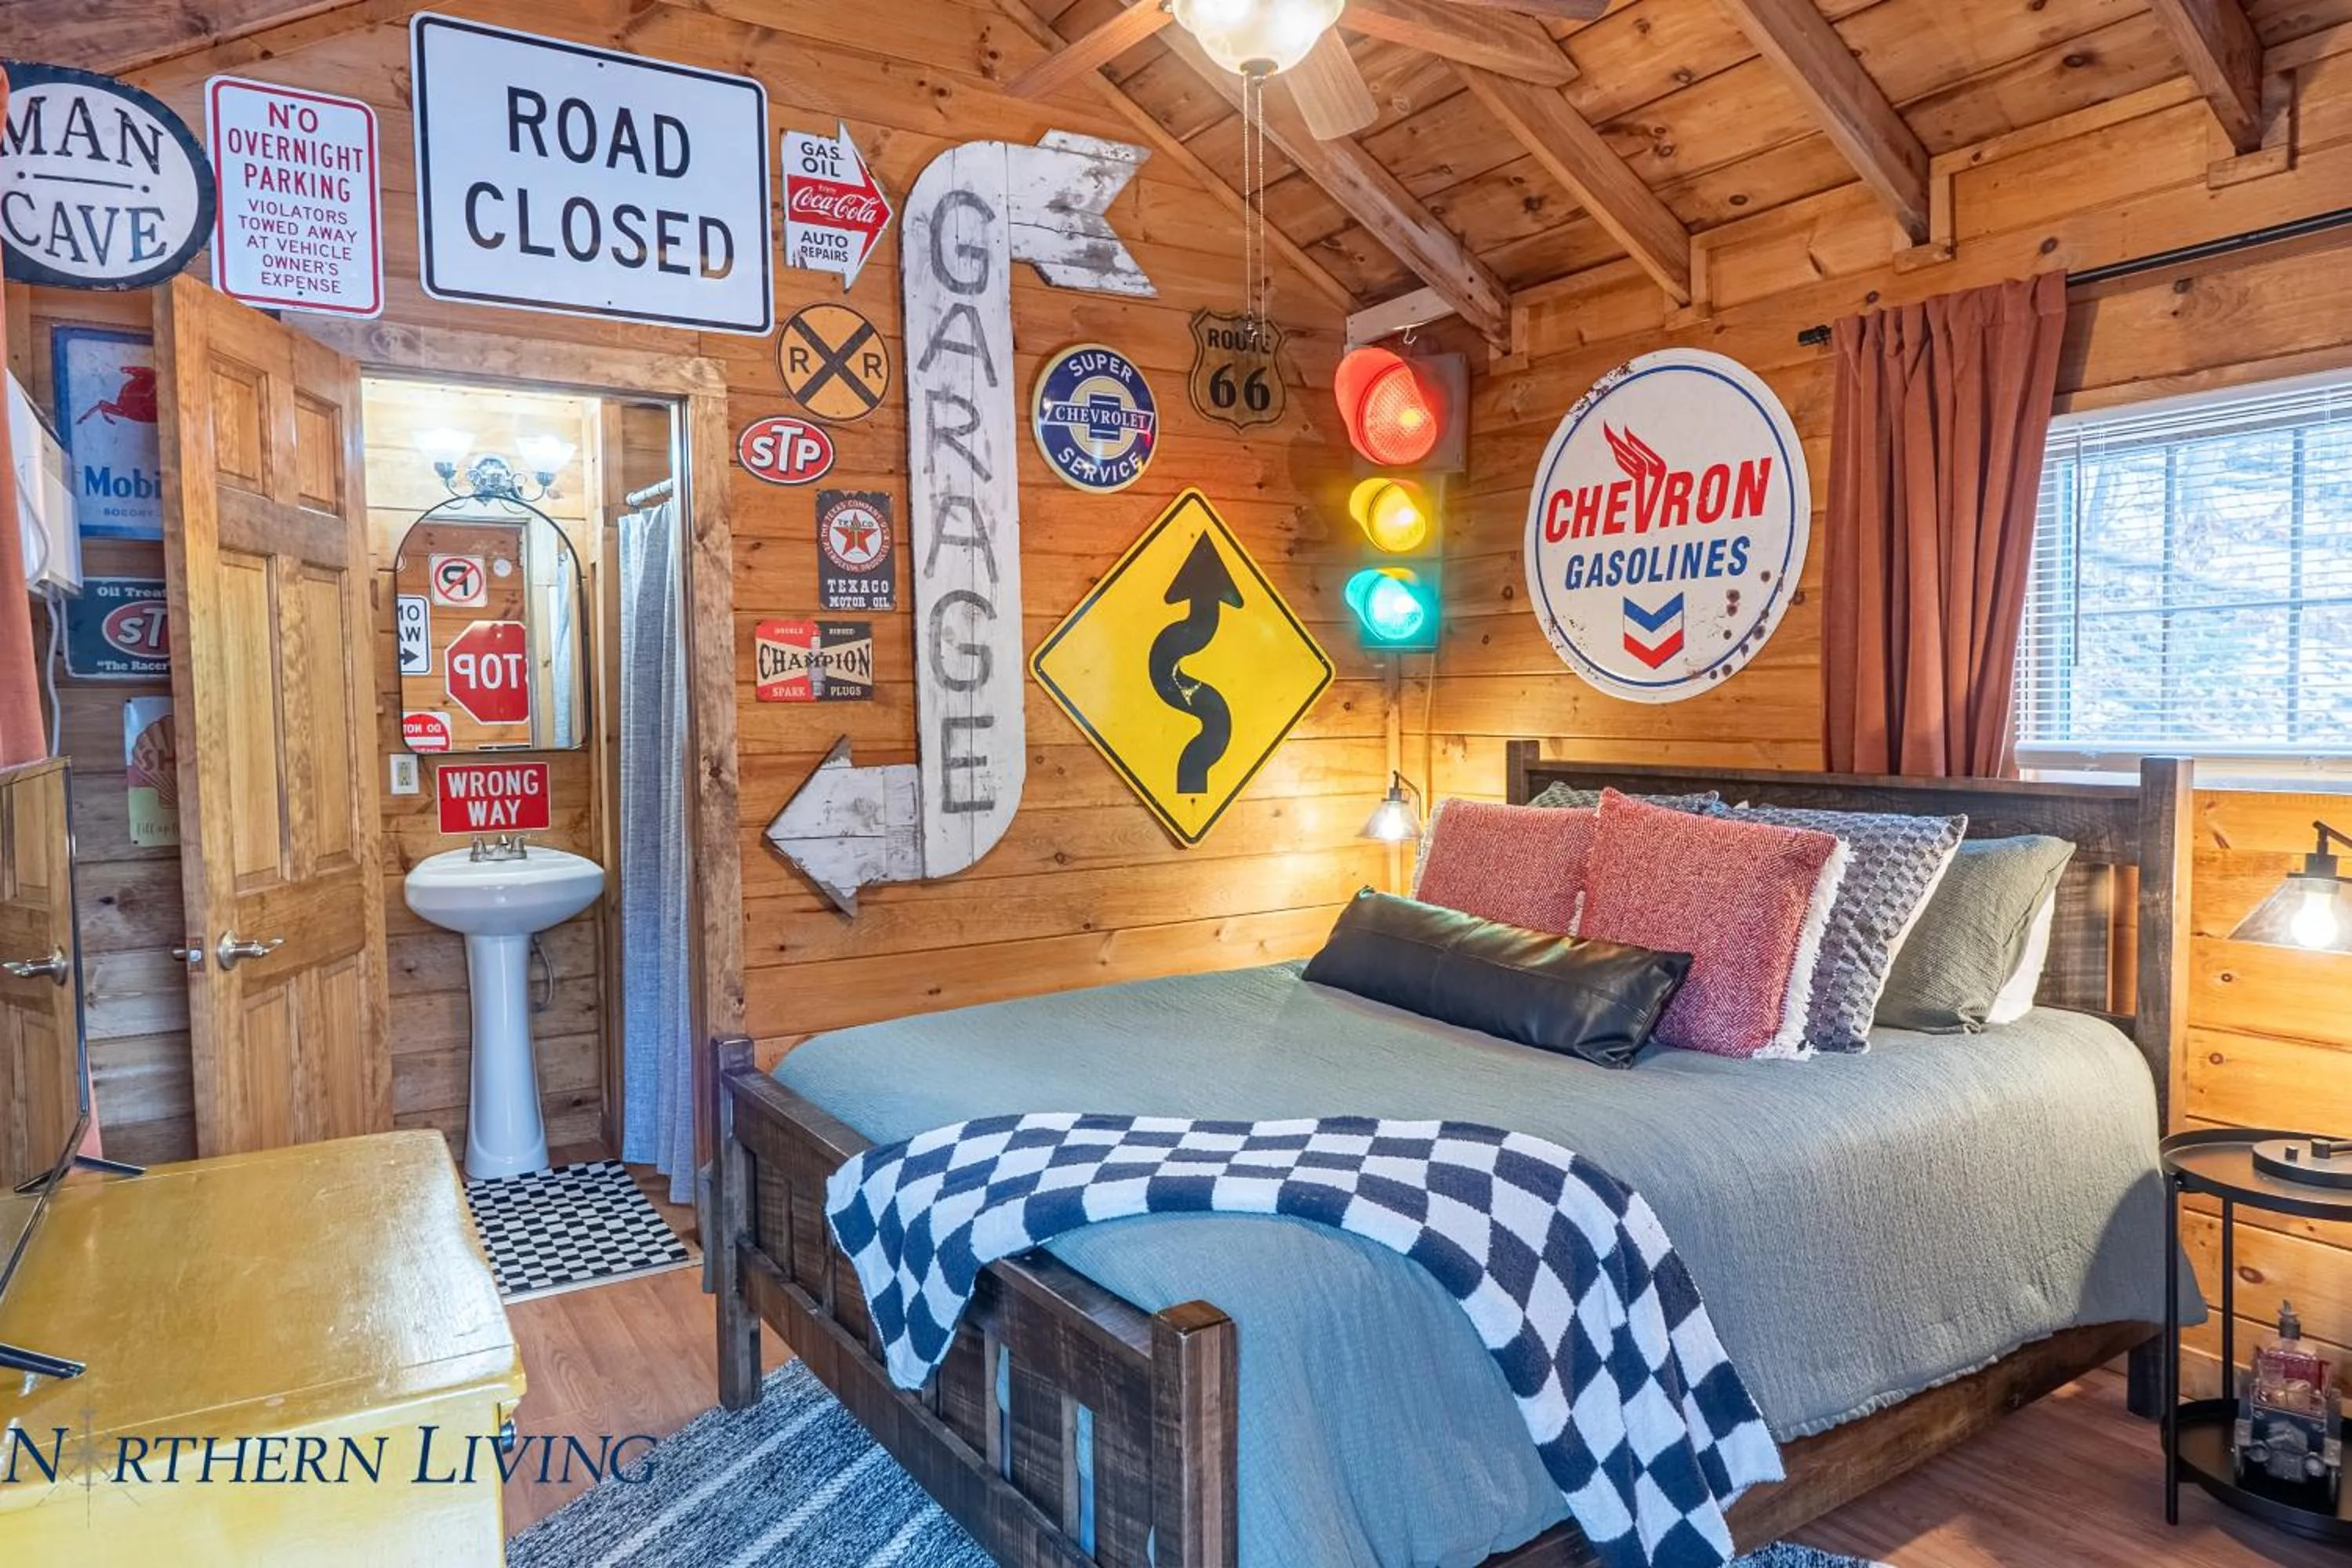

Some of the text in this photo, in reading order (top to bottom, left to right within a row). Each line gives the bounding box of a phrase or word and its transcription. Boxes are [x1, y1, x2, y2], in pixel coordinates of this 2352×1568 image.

[268, 102, 318, 133] NO
[506, 85, 691, 179] ROAD
[0, 96, 163, 175] MAN
[228, 128, 363, 172] OVERNIGHT
[801, 141, 840, 161] GAS
[245, 162, 350, 202] PARKING
[802, 158, 840, 177] OIL
[248, 199, 347, 225] VIOLATORS
[792, 186, 880, 223] Coca-Cola
[2, 191, 167, 267] CAVE
[238, 215, 358, 244] TOWED AWAY
[465, 181, 734, 280] CLOSED
[801, 230, 848, 248] AUTO
[247, 235, 351, 260] AT VEHICLE
[800, 245, 848, 263] REPAIRS
[263, 255, 339, 276] OWNER'S
[261, 272, 342, 294] EXPENSE
[1208, 328, 1271, 354] ROUTE
[1069, 354, 1132, 383] SUPER
[1209, 363, 1270, 412] 66
[1055, 406, 1147, 429] CHEVROLET
[750, 425, 822, 474] STP
[1058, 447, 1142, 483] SERVICE
[1544, 421, 1772, 543] CHEVRON
[917, 188, 999, 814] GARAGE
[1565, 535, 1750, 590] GASOLINES
[97, 586, 120, 597] Oil
[828, 579, 889, 593] TEXACO
[829, 596, 890, 608] MOTOR OIL
[759, 643, 871, 679] CHAMPION
[772, 687, 862, 697] SPARK PLUGS
[447, 769, 539, 798] WRONG
[467, 799, 521, 827] WAY
